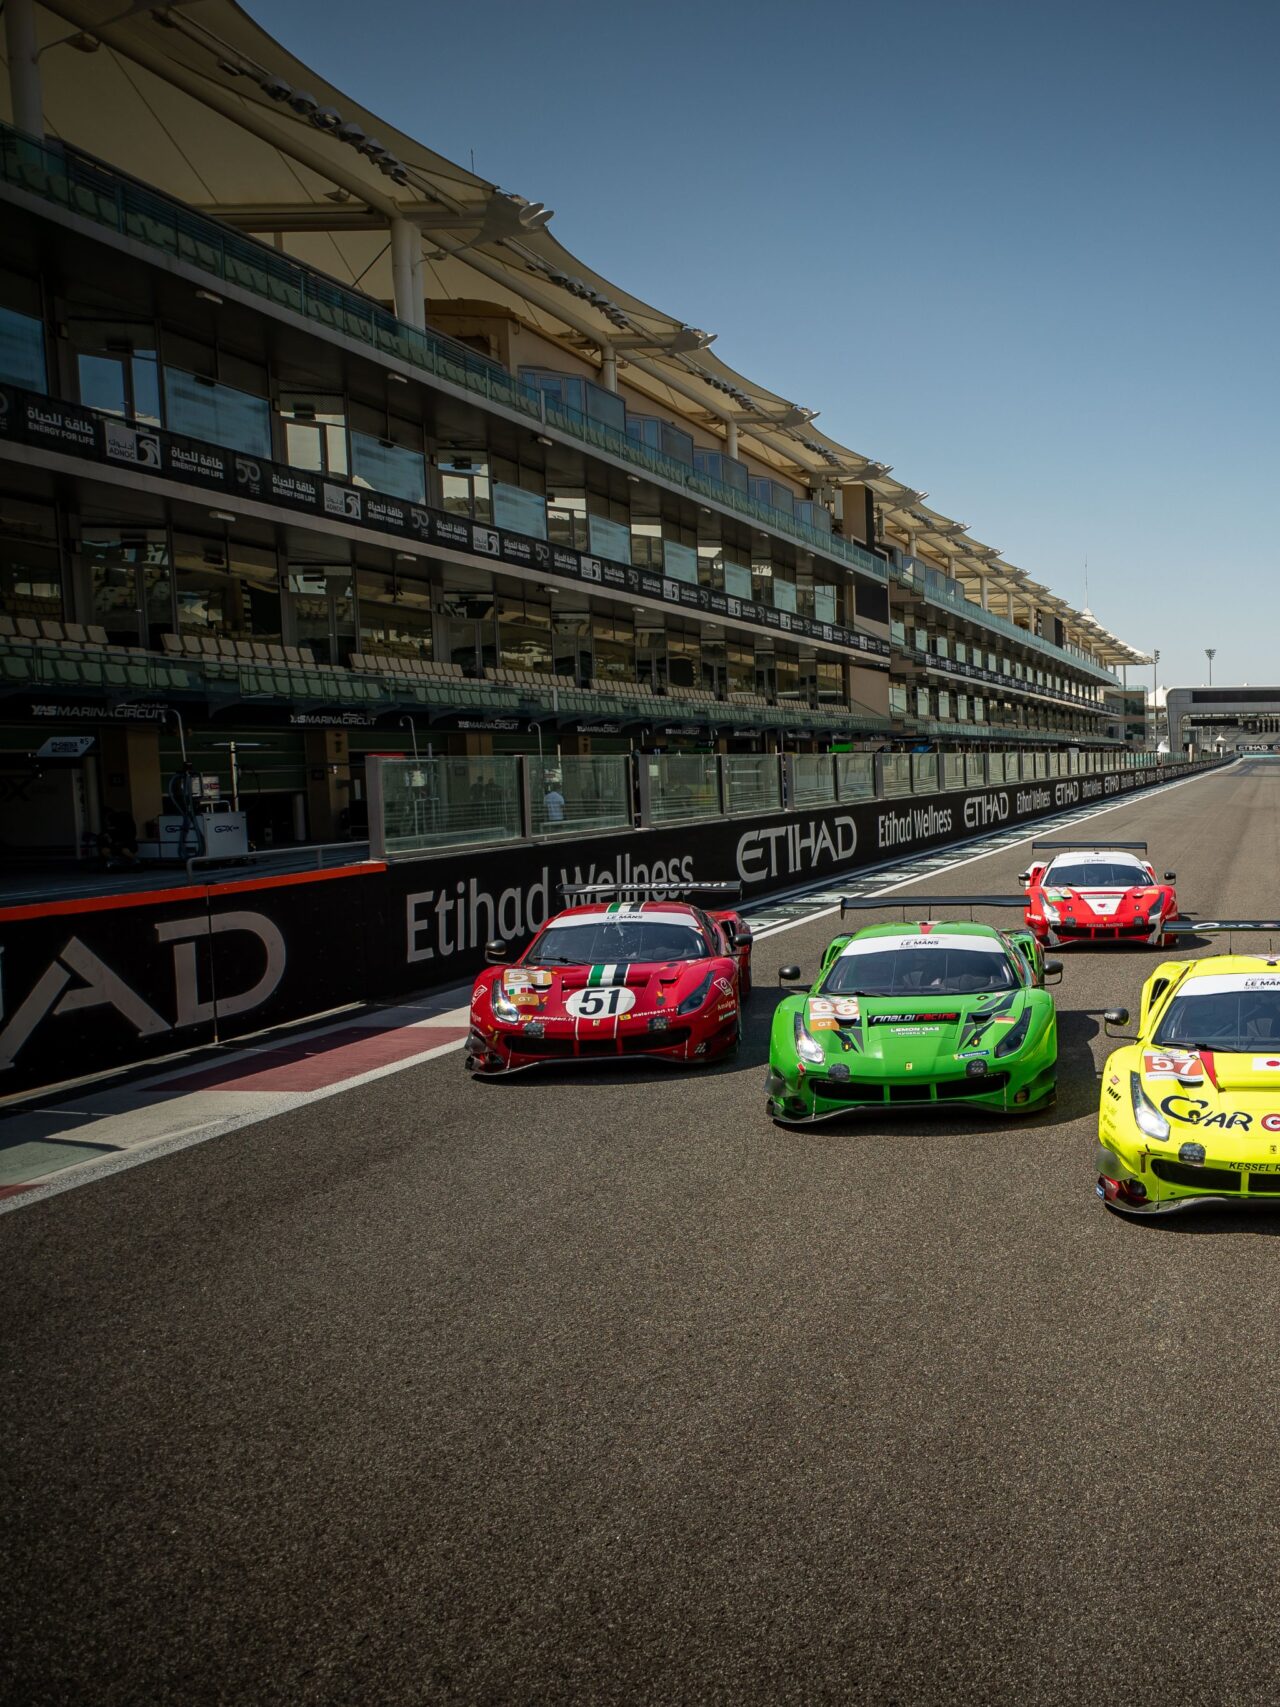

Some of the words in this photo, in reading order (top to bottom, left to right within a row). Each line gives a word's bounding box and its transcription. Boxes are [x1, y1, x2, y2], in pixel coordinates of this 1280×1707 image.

[27, 422, 60, 437] ENERGY
[61, 429, 77, 441] FOR
[78, 434, 95, 446] LIFE
[109, 447, 135, 460] ADNOC
[1055, 781, 1079, 806] ETIHAD
[964, 792, 1009, 828] ETIHAD
[878, 809, 912, 848] Etihad
[914, 805, 952, 839] Wellness
[736, 815, 858, 883] ETIHAD
[406, 867, 550, 964] Etihad
[560, 853, 694, 908] Wellness
[508, 972, 547, 984] 51
[0, 911, 287, 1070] AD
[578, 989, 621, 1016] 51
[632, 1007, 675, 1018] motorsport.tv
[812, 1001, 858, 1016] 66
[1152, 1056, 1197, 1075] 57
[1229, 1161, 1271, 1172] KESSEL
